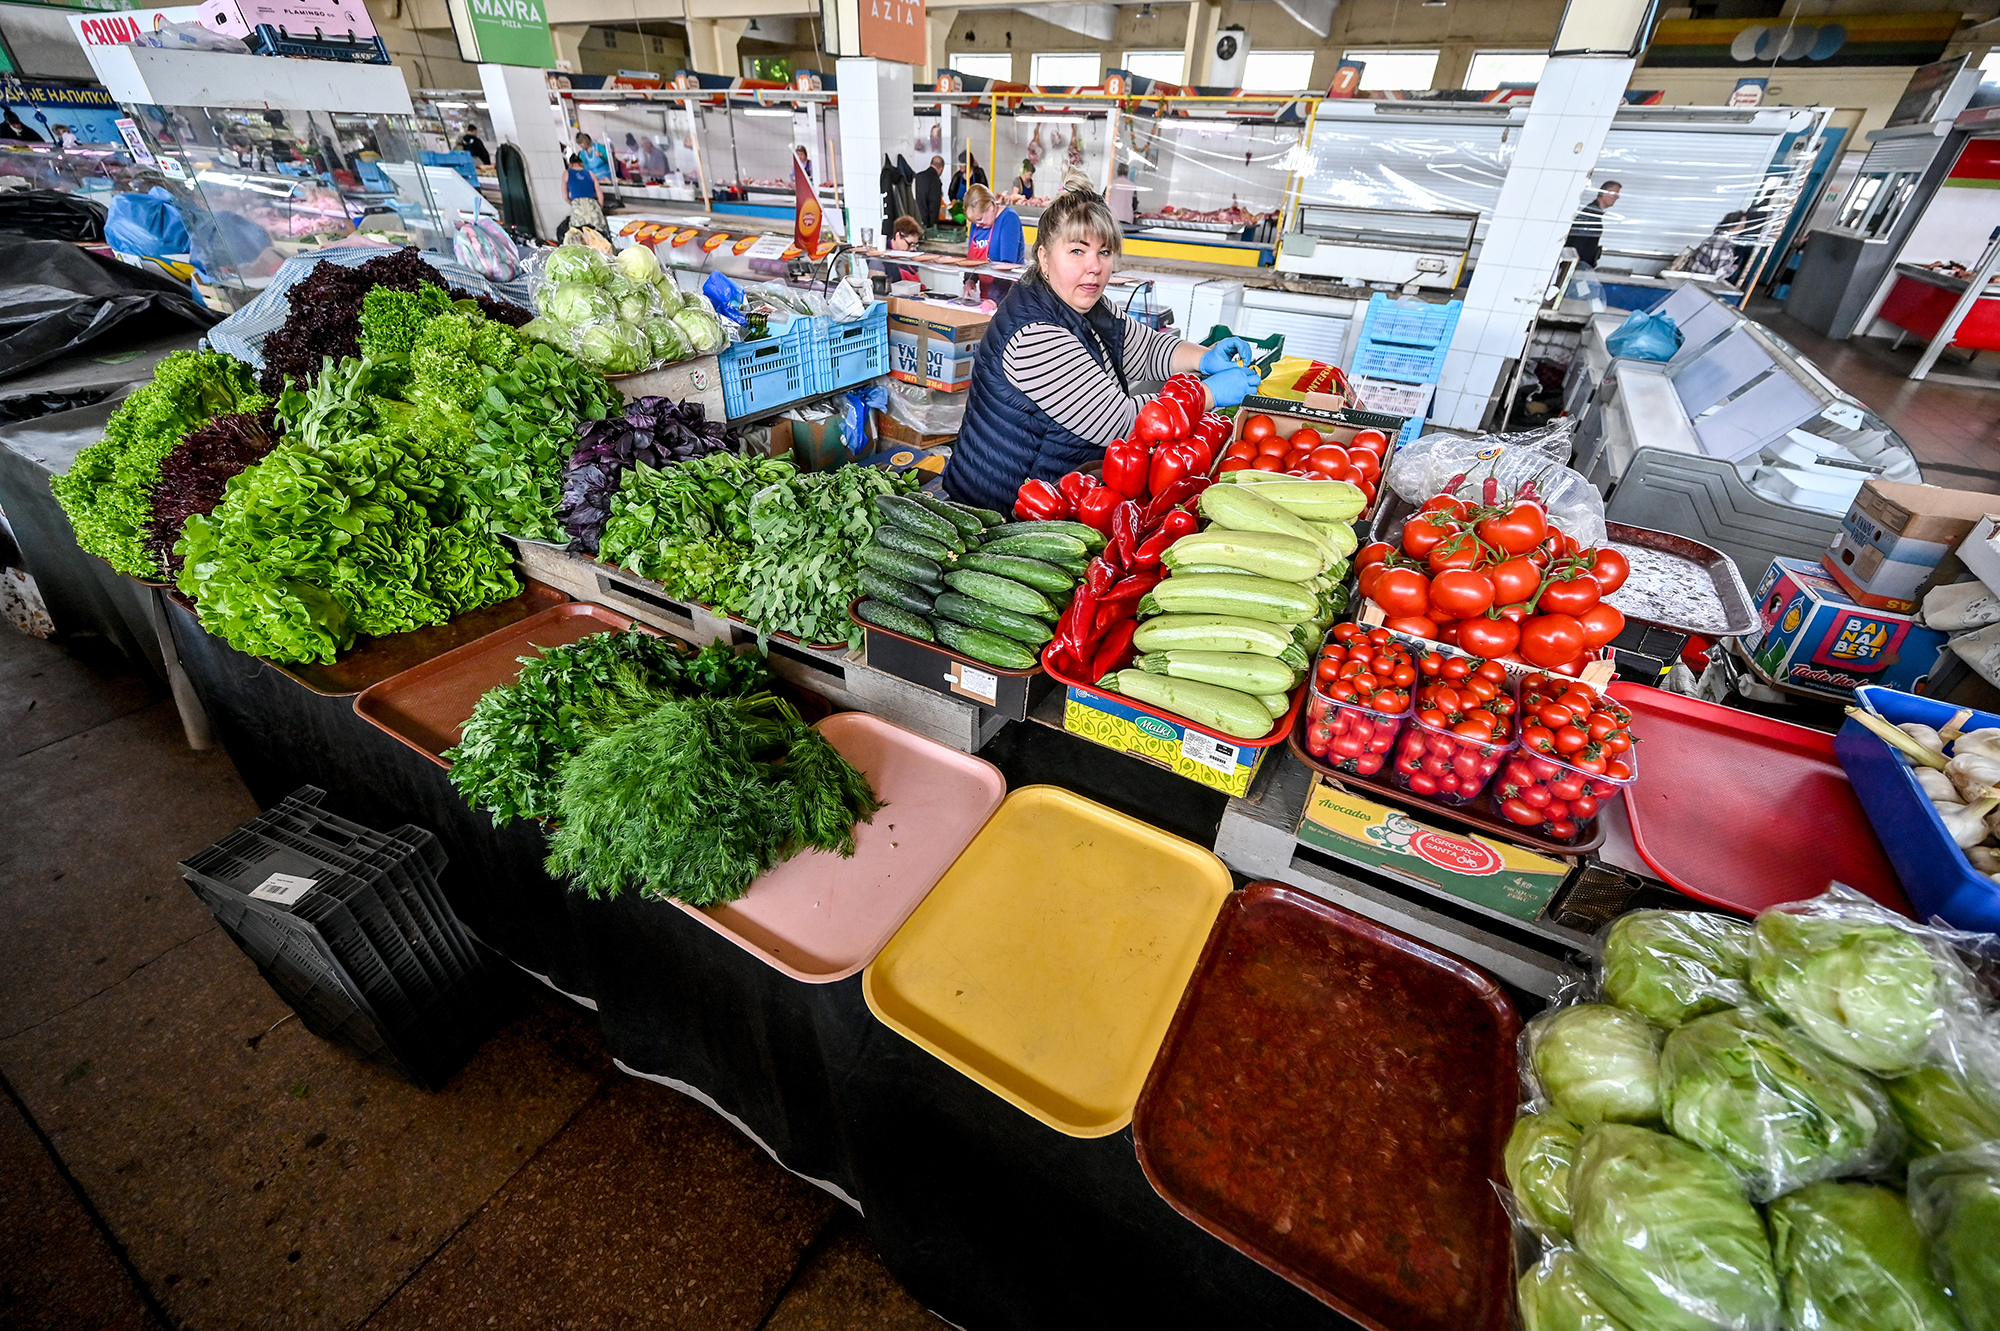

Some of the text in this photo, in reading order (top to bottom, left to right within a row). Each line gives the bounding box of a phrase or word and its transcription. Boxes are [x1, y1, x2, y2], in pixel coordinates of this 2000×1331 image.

[284, 8, 326, 17] FLAMINGO
[472, 0, 543, 23] MAVRA
[871, 0, 914, 26] AZIA
[501, 19, 523, 29] PIZZA
[799, 77, 809, 92] 10
[940, 78, 948, 92] 9
[1109, 78, 1119, 95] 8
[1340, 70, 1354, 89] 7
[0, 86, 114, 105] ДНЫЕ НАПИТКИ
[928, 323, 952, 332] PRODUCT
[897, 343, 944, 366] DONA
[898, 357, 942, 378] PRMA
[904, 374, 943, 389] PREUM
[1846, 619, 1877, 635] BA
[1840, 630, 1871, 646] NA
[1833, 641, 1881, 658] BEST
[1503, 662, 1529, 676] Blu
[1790, 663, 1831, 682] Taste
[1830, 672, 1855, 687] the
[1139, 719, 1172, 738] Malki
[1318, 799, 1372, 822] Avocados
[1424, 842, 1458, 858] SANTA
[1427, 836, 1483, 858] AGROCROP
